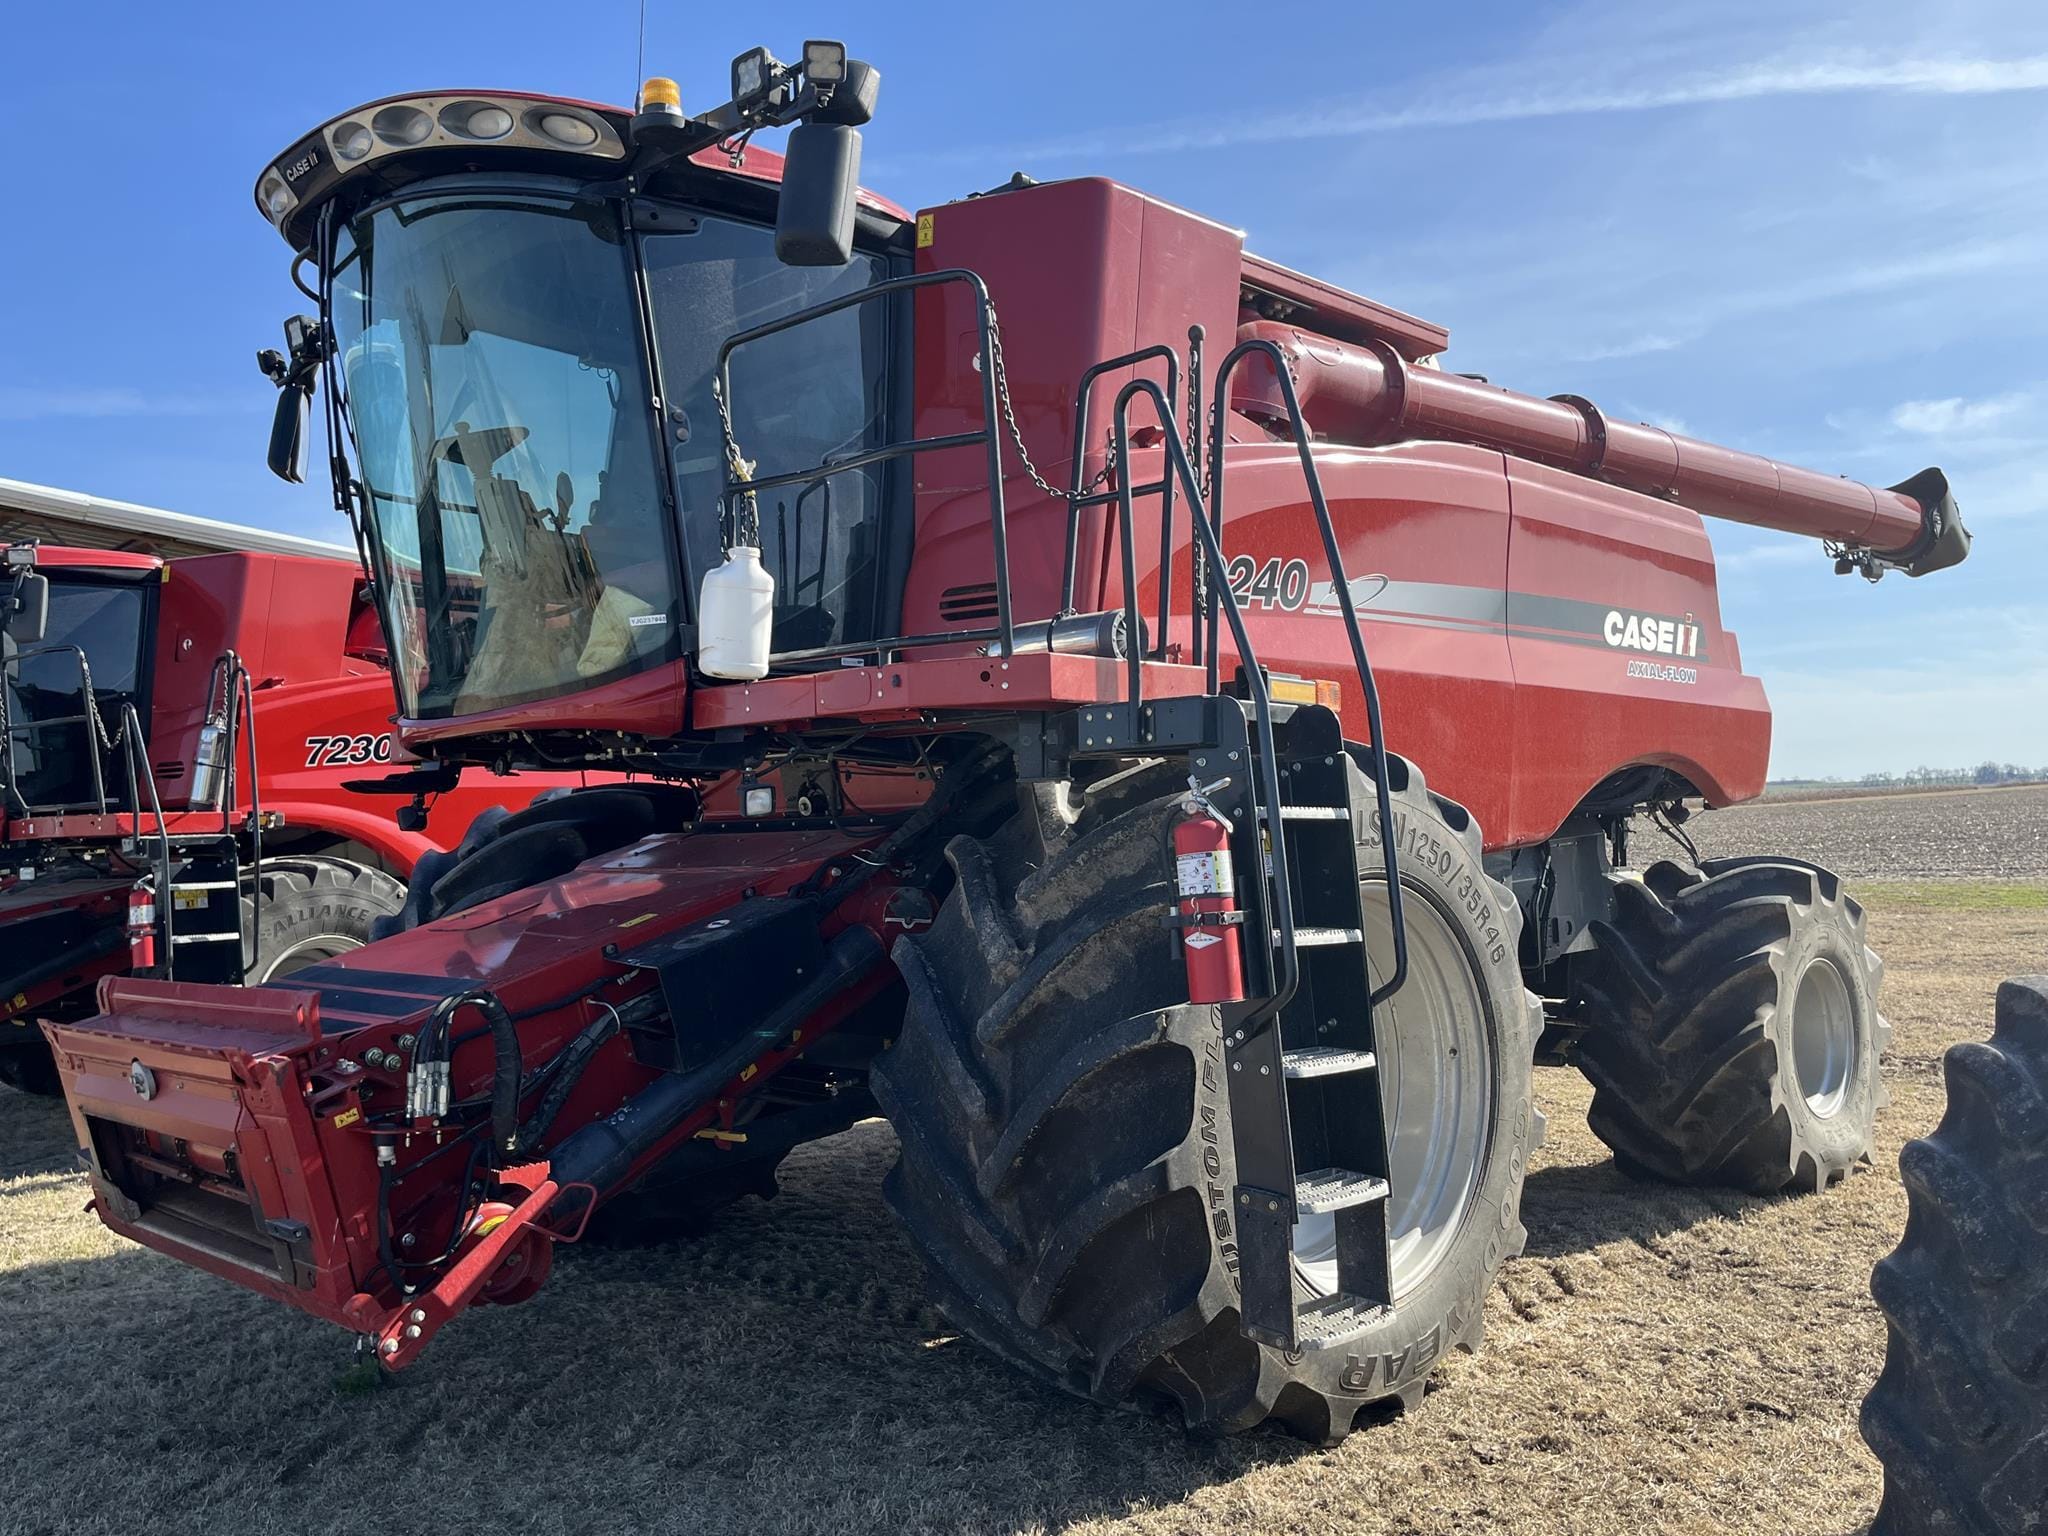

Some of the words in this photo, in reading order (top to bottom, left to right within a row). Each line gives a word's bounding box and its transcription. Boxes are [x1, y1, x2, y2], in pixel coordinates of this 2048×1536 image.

[1218, 553, 1309, 612] 240
[1603, 610, 1675, 654] CASE
[1627, 660, 1697, 684] AXIAL-FLOW
[305, 733, 392, 767] 7230
[273, 904, 370, 937] ALLIANCE
[1200, 1105, 1241, 1295] USTOM
